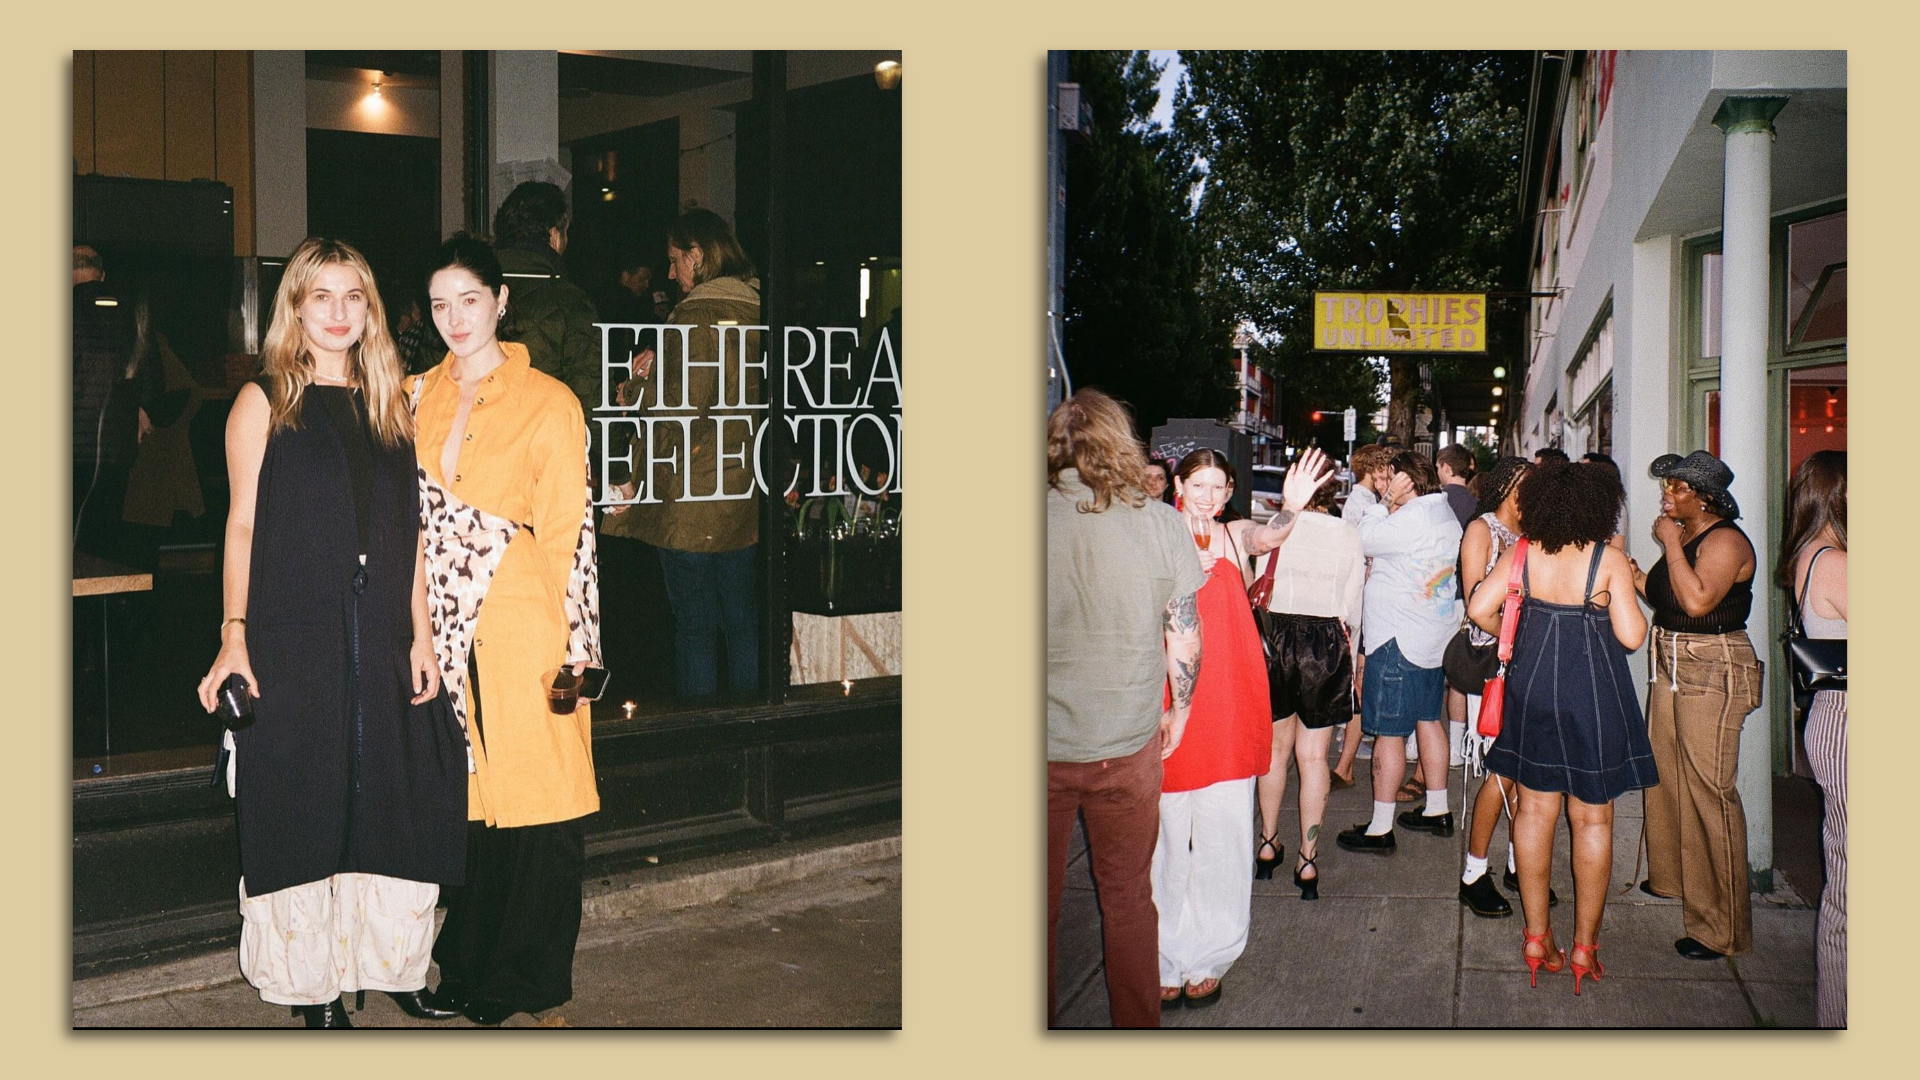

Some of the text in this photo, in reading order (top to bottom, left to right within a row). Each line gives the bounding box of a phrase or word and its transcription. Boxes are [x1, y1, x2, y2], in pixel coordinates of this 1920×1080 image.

[592, 322, 902, 411] ETHEREA
[1323, 327, 1476, 348] UNLIMITED
[585, 413, 902, 506] EFLECTIO
